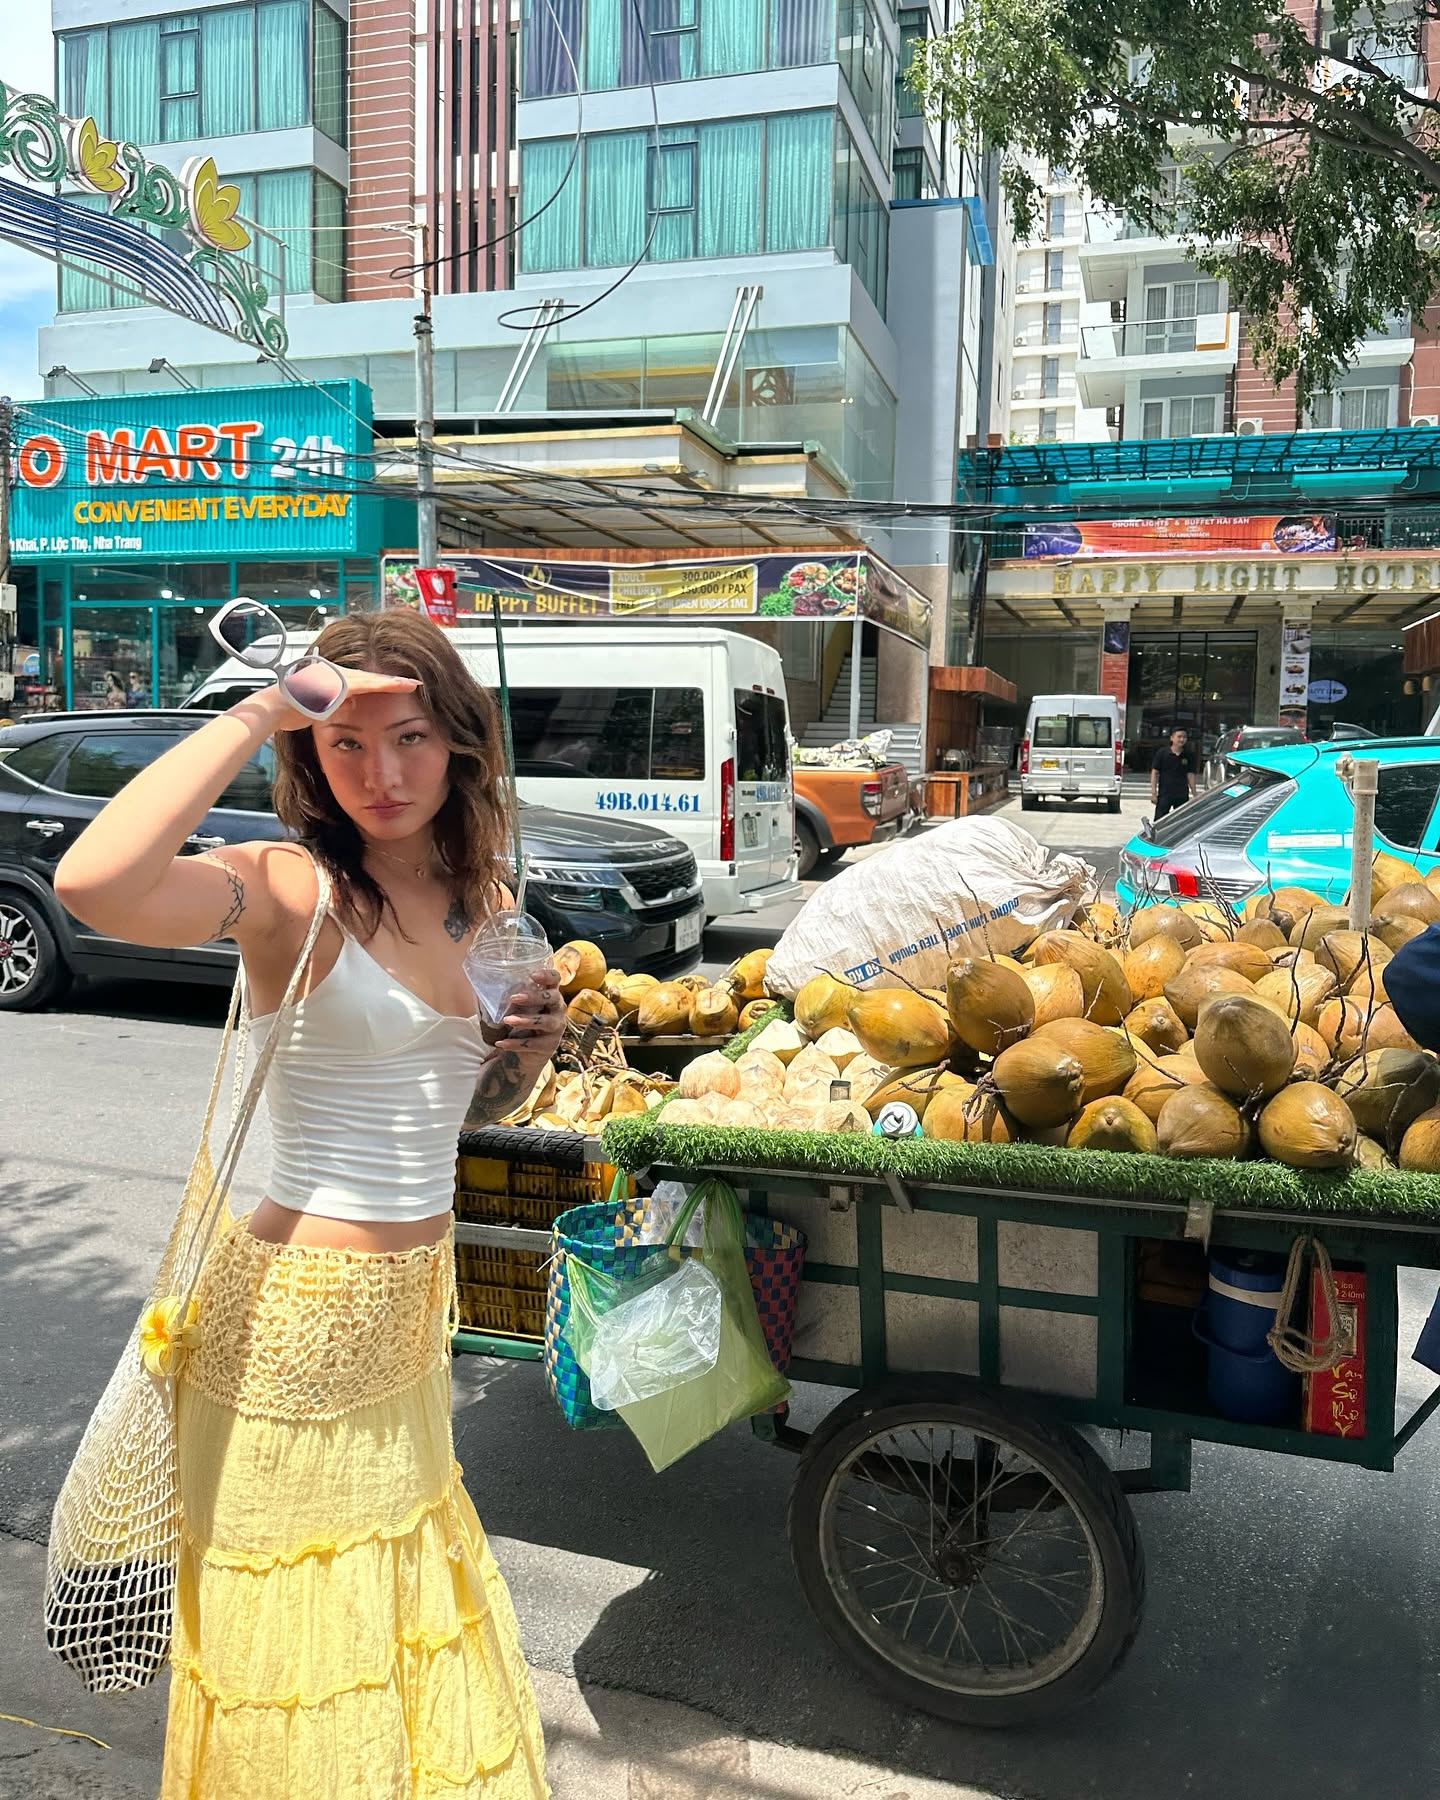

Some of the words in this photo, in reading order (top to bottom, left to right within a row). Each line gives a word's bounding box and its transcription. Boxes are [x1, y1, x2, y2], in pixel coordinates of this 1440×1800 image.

[10, 434, 66, 488] O
[86, 420, 264, 484] MART
[270, 435, 346, 478] 24h
[73, 497, 222, 524] CONVENIENT
[224, 494, 352, 520] EVERYDAY
[1142, 518, 1170, 528] LIGHTS
[1184, 518, 1215, 527] BUFFET
[40, 537, 50, 551] P.
[93, 535, 113, 550] Nha
[114, 535, 142, 551] Trang
[682, 570, 721, 581] 300.000
[1053, 563, 1163, 594] HAPPY
[1194, 562, 1300, 593] LIGHT
[1335, 562, 1440, 591] HOTE
[728, 583, 747, 594] PAX
[475, 591, 529, 614] HAPPY
[535, 592, 597, 615] BUFFET
[595, 790, 701, 813] 49B.014.61
[847, 969, 865, 985] KG
[865, 961, 882, 977] 50
